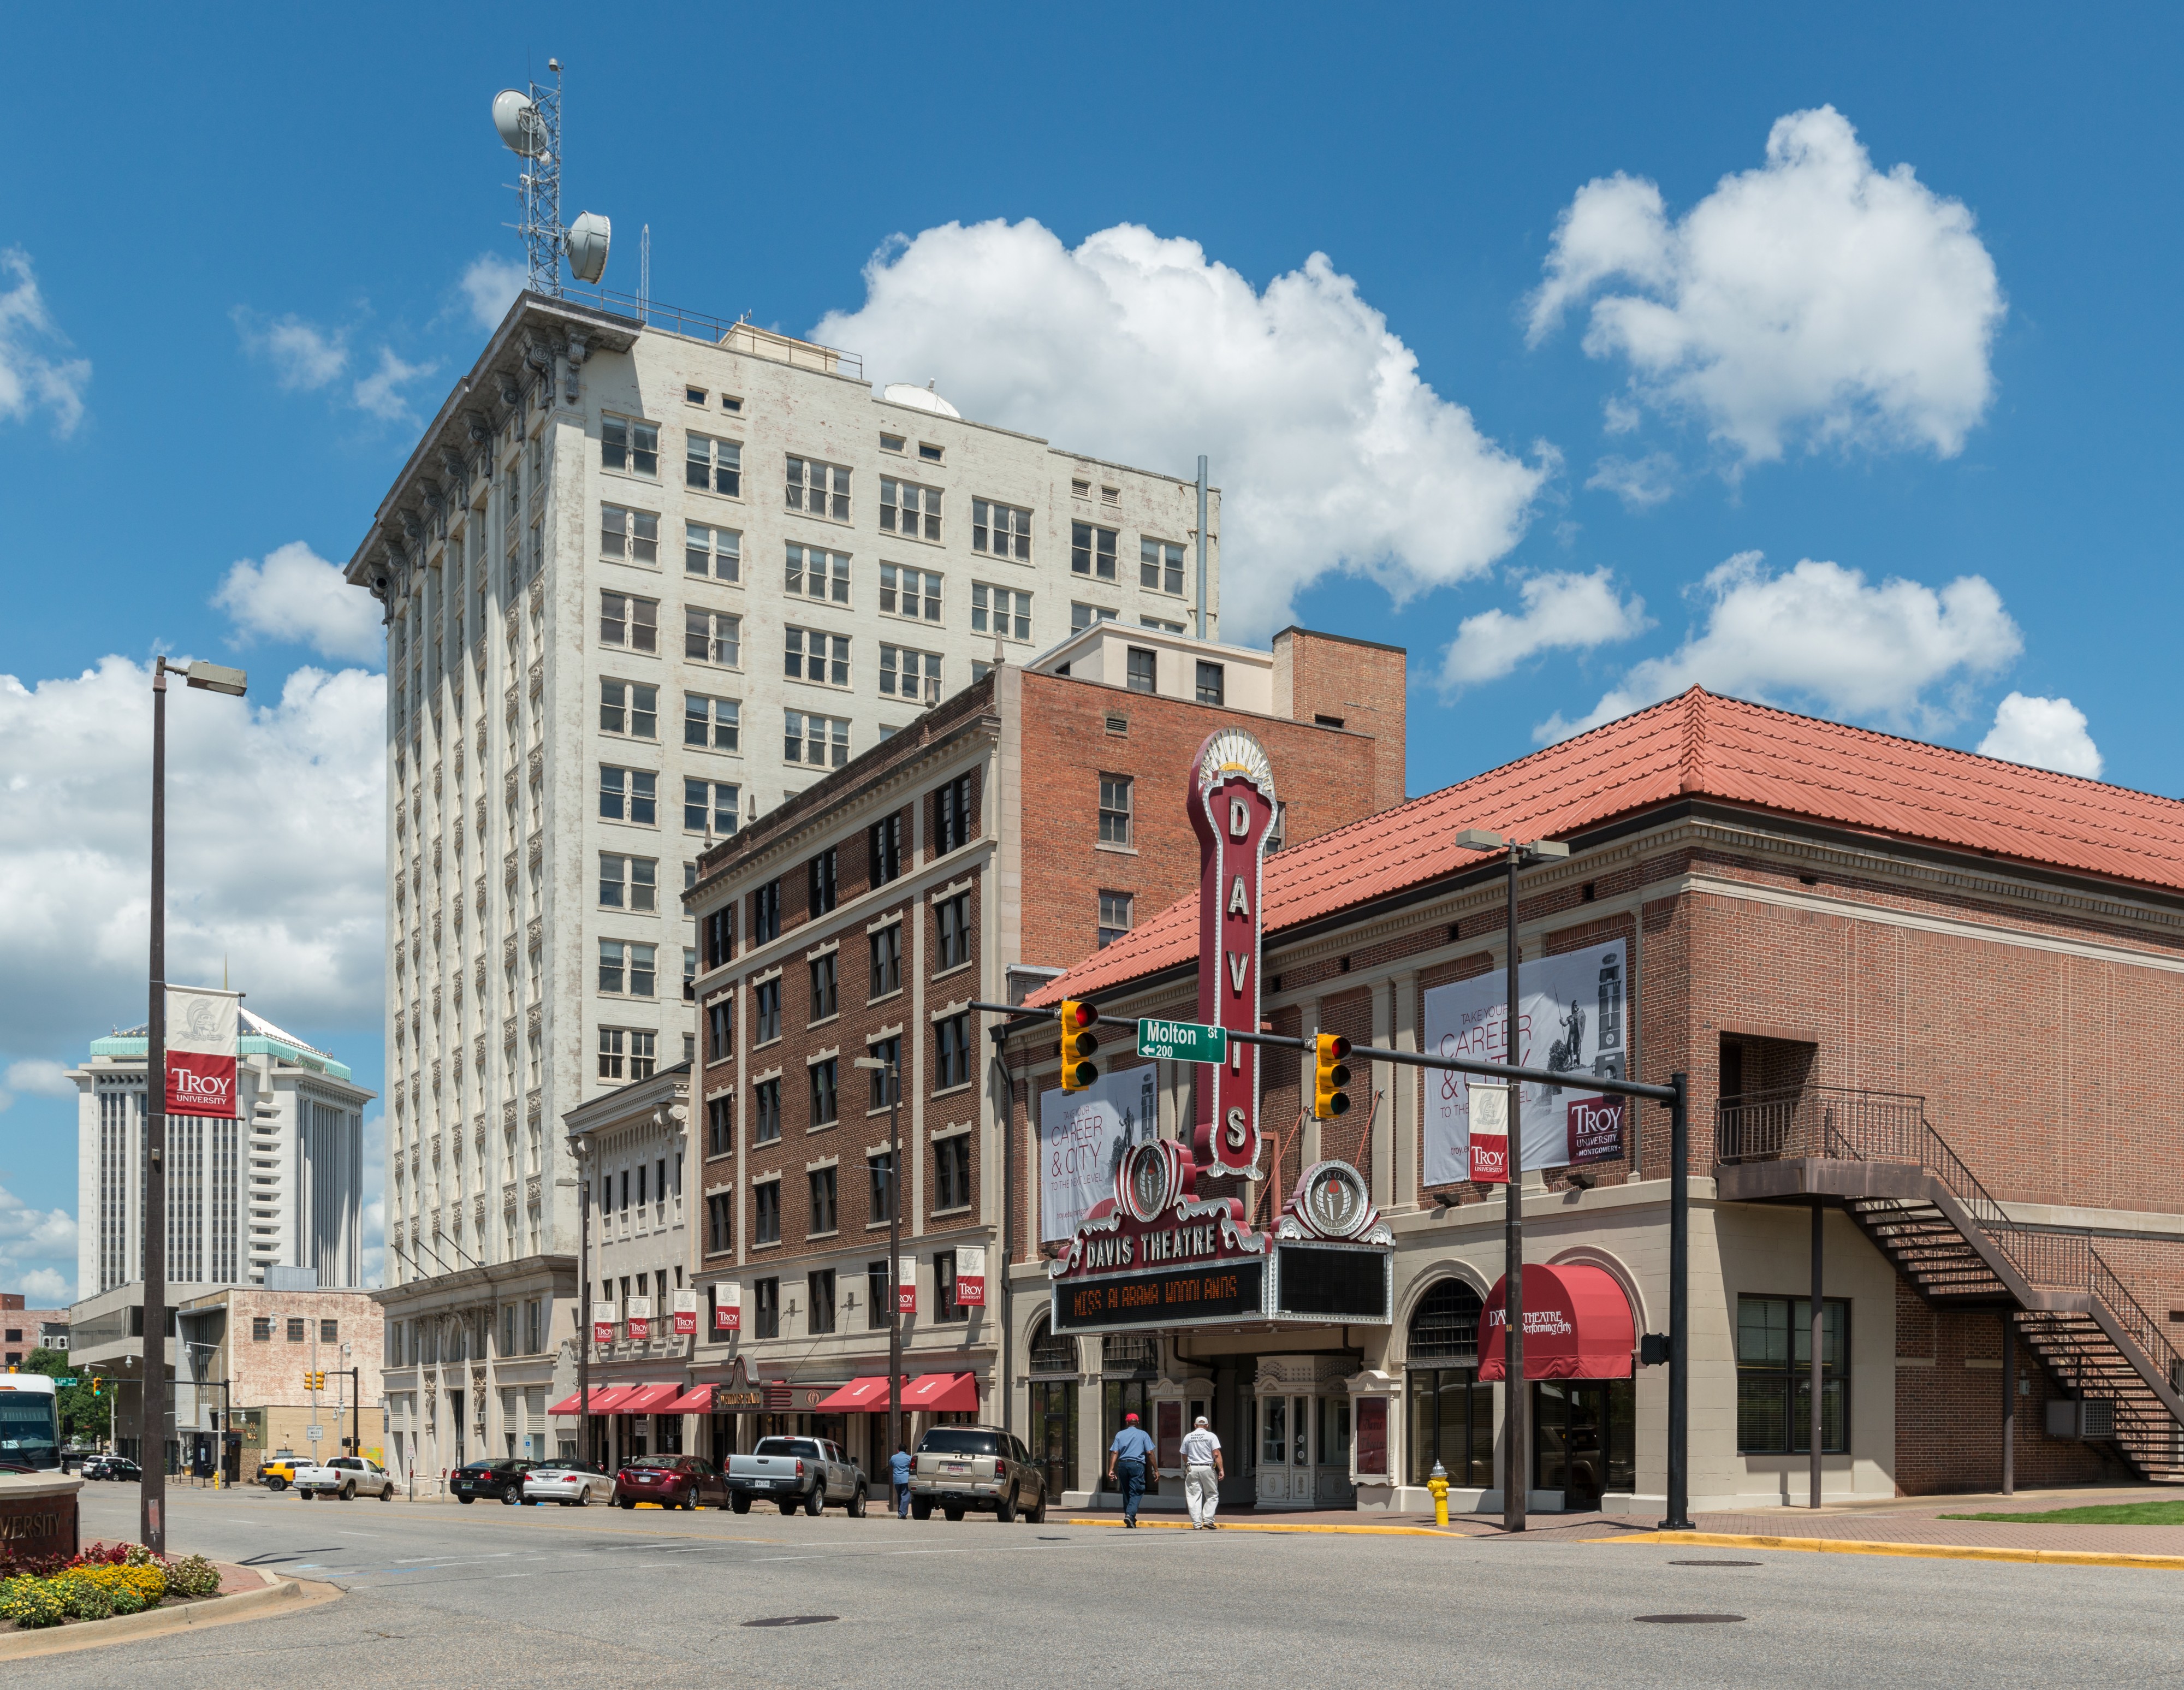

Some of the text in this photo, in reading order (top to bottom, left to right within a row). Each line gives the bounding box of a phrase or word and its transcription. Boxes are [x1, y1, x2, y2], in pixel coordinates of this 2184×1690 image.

[1226, 796, 1251, 1147] DAVIS
[1461, 1010, 1482, 1025] TAKE
[1147, 1021, 1218, 1045] Molton St
[1156, 1045, 1173, 1058] 200
[171, 1068, 232, 1095] TROY
[176, 1094, 227, 1105] UNIVERSITY
[1063, 1105, 1090, 1120] TAKE YOUR
[1440, 1102, 1469, 1119] TO THE
[1571, 1104, 1623, 1135] TROY
[1051, 1116, 1103, 1147] CAREER
[1576, 1133, 1617, 1147] UNIVERSITY
[1141, 1149, 1161, 1163] TROY
[1471, 1146, 1505, 1165] TROY
[1578, 1145, 1618, 1157] MONTGOMERY
[1052, 1141, 1102, 1177] & CITY
[1051, 1173, 1103, 1191] TO THE NEXT LEVEL
[1319, 1171, 1349, 1182] TROY
[1315, 1211, 1353, 1227] UNIVERSITY
[1087, 1223, 1218, 1268] DAVIS THEATRE
[958, 1283, 983, 1295] TROY
[899, 1295, 914, 1303] ROY
[675, 1317, 695, 1326] TROY
[718, 1312, 739, 1321] TROY
[1522, 1311, 1563, 1323] THEATRE
[596, 1327, 614, 1335] TROY
[630, 1323, 648, 1332] TROY
[1557, 1321, 1572, 1335] Arts
[1363, 1419, 1383, 1430] Davis
